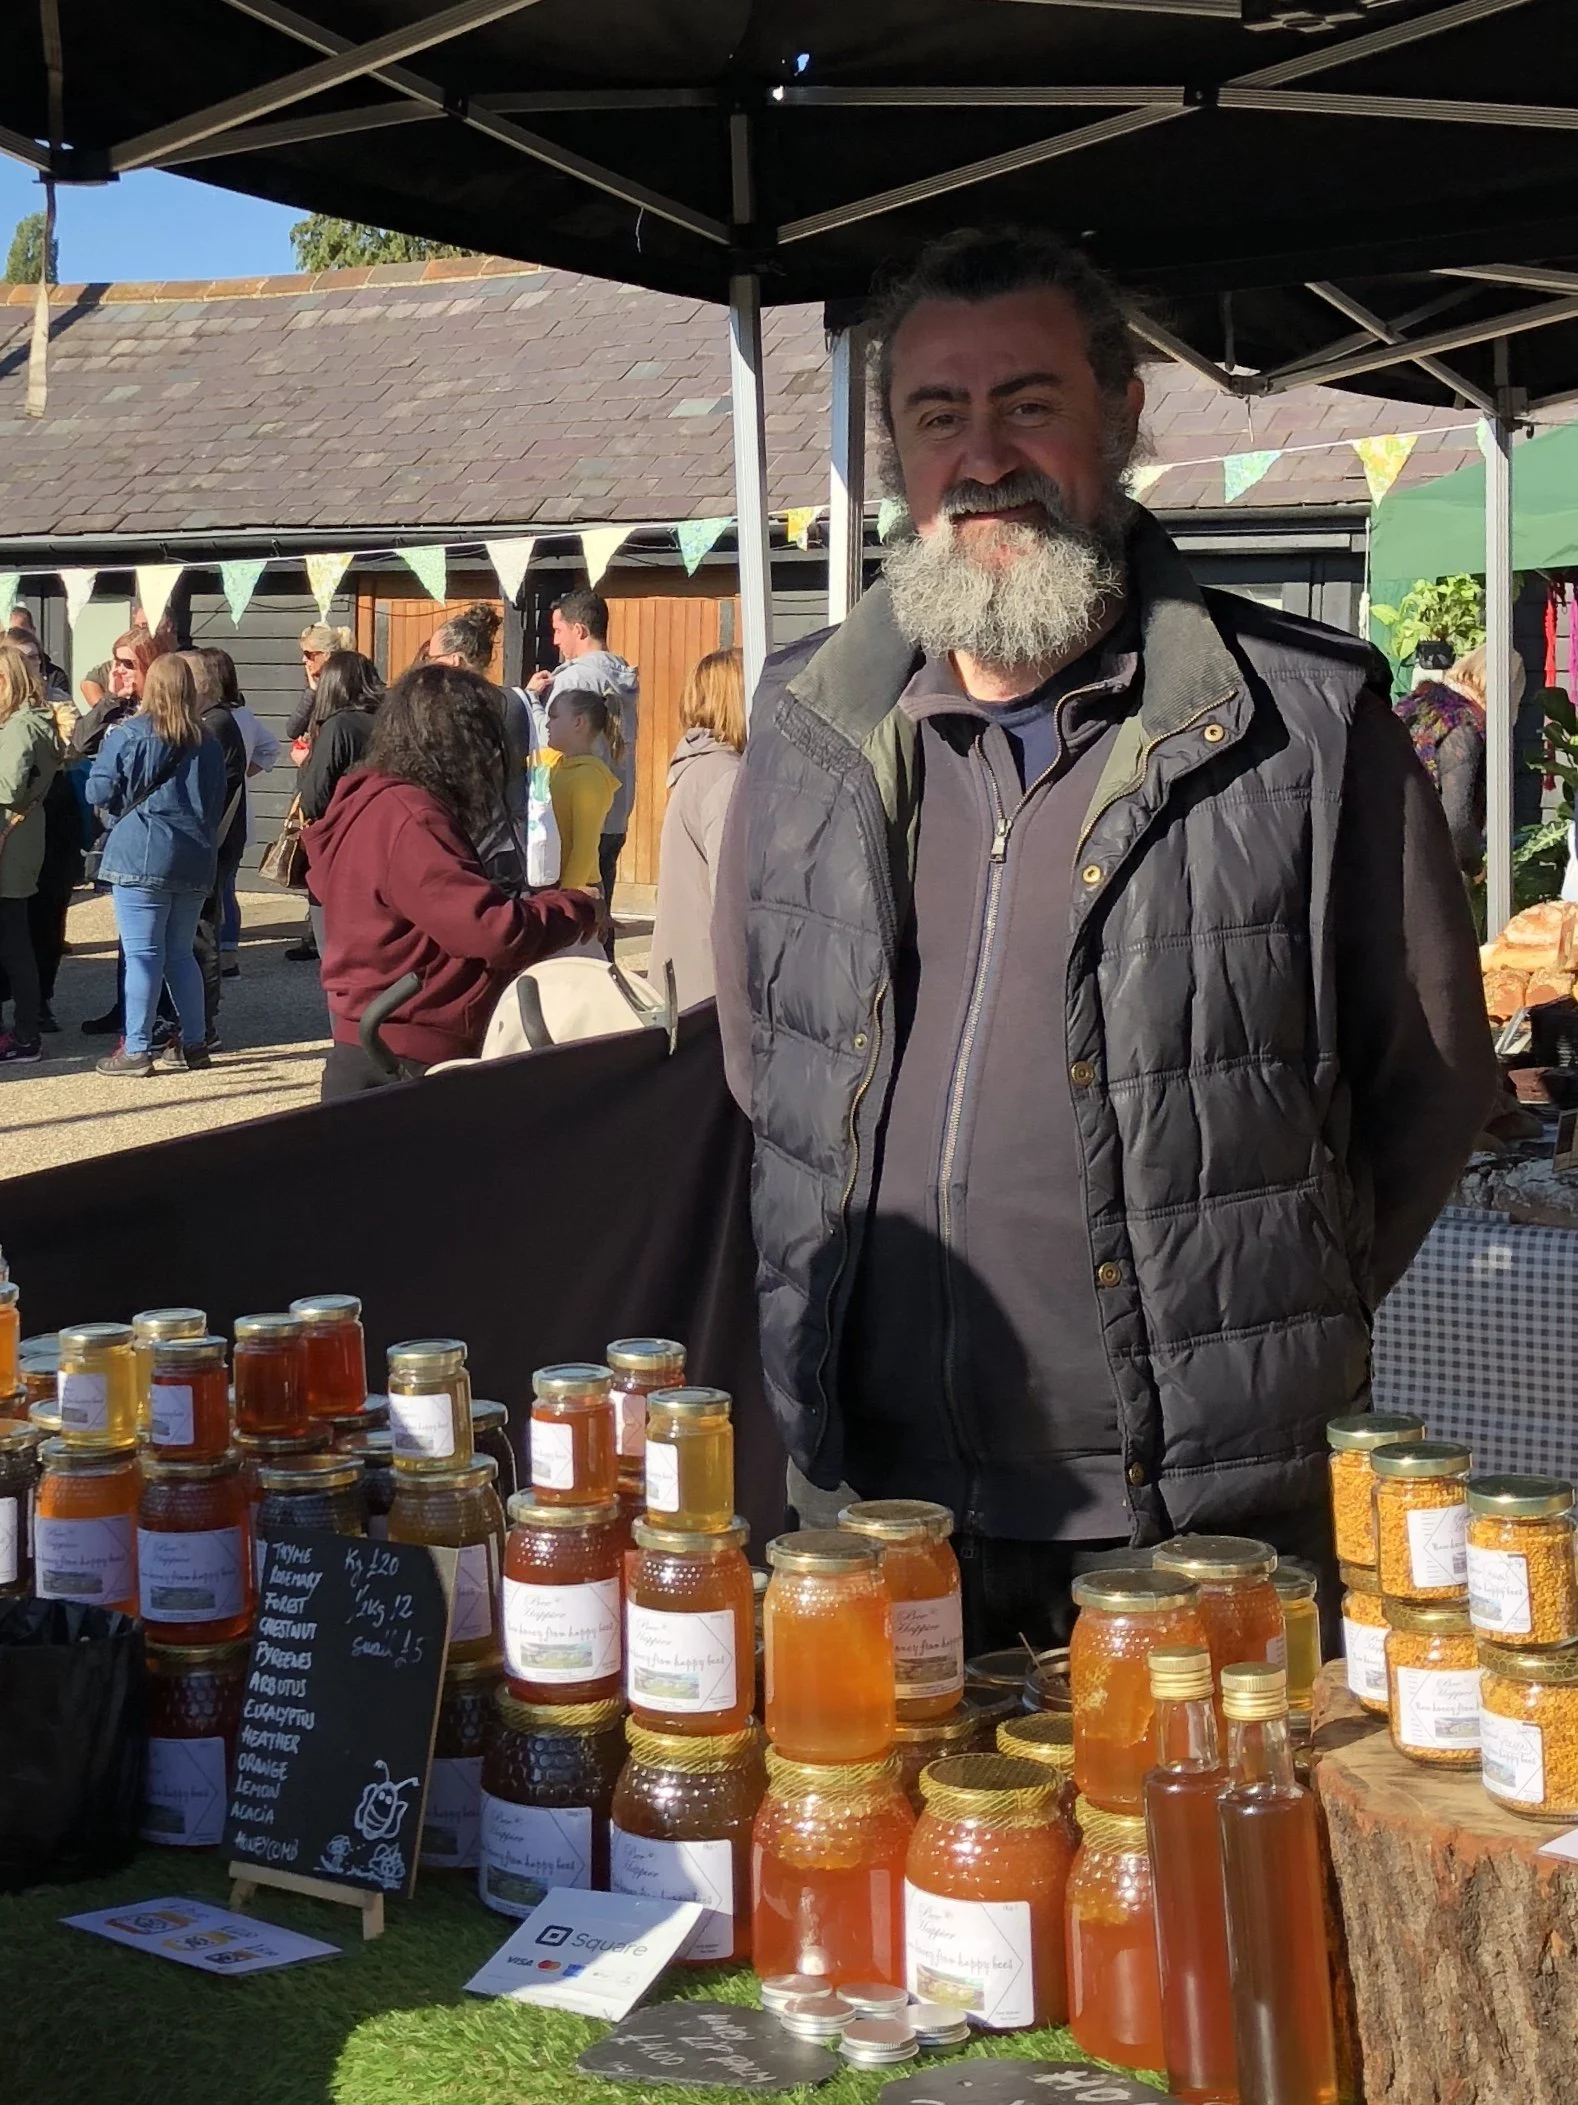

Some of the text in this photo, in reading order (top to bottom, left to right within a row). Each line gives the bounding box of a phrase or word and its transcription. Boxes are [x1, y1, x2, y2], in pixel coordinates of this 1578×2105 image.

[272, 1541, 313, 1565] THYME
[366, 1547, 400, 1578] £20
[269, 1565, 323, 1599] ROSEMARY
[259, 1617, 317, 1640] CHESTNUT
[249, 1671, 306, 1697] ARBUTUS
[243, 1699, 315, 1730] EUCALYPTUS
[241, 1725, 301, 1754] HEATHER
[238, 1753, 289, 1781] ORANGE
[235, 1773, 281, 1798] LEMON
[571, 1933, 648, 1957] Square
[507, 1956, 534, 1967] VISA
